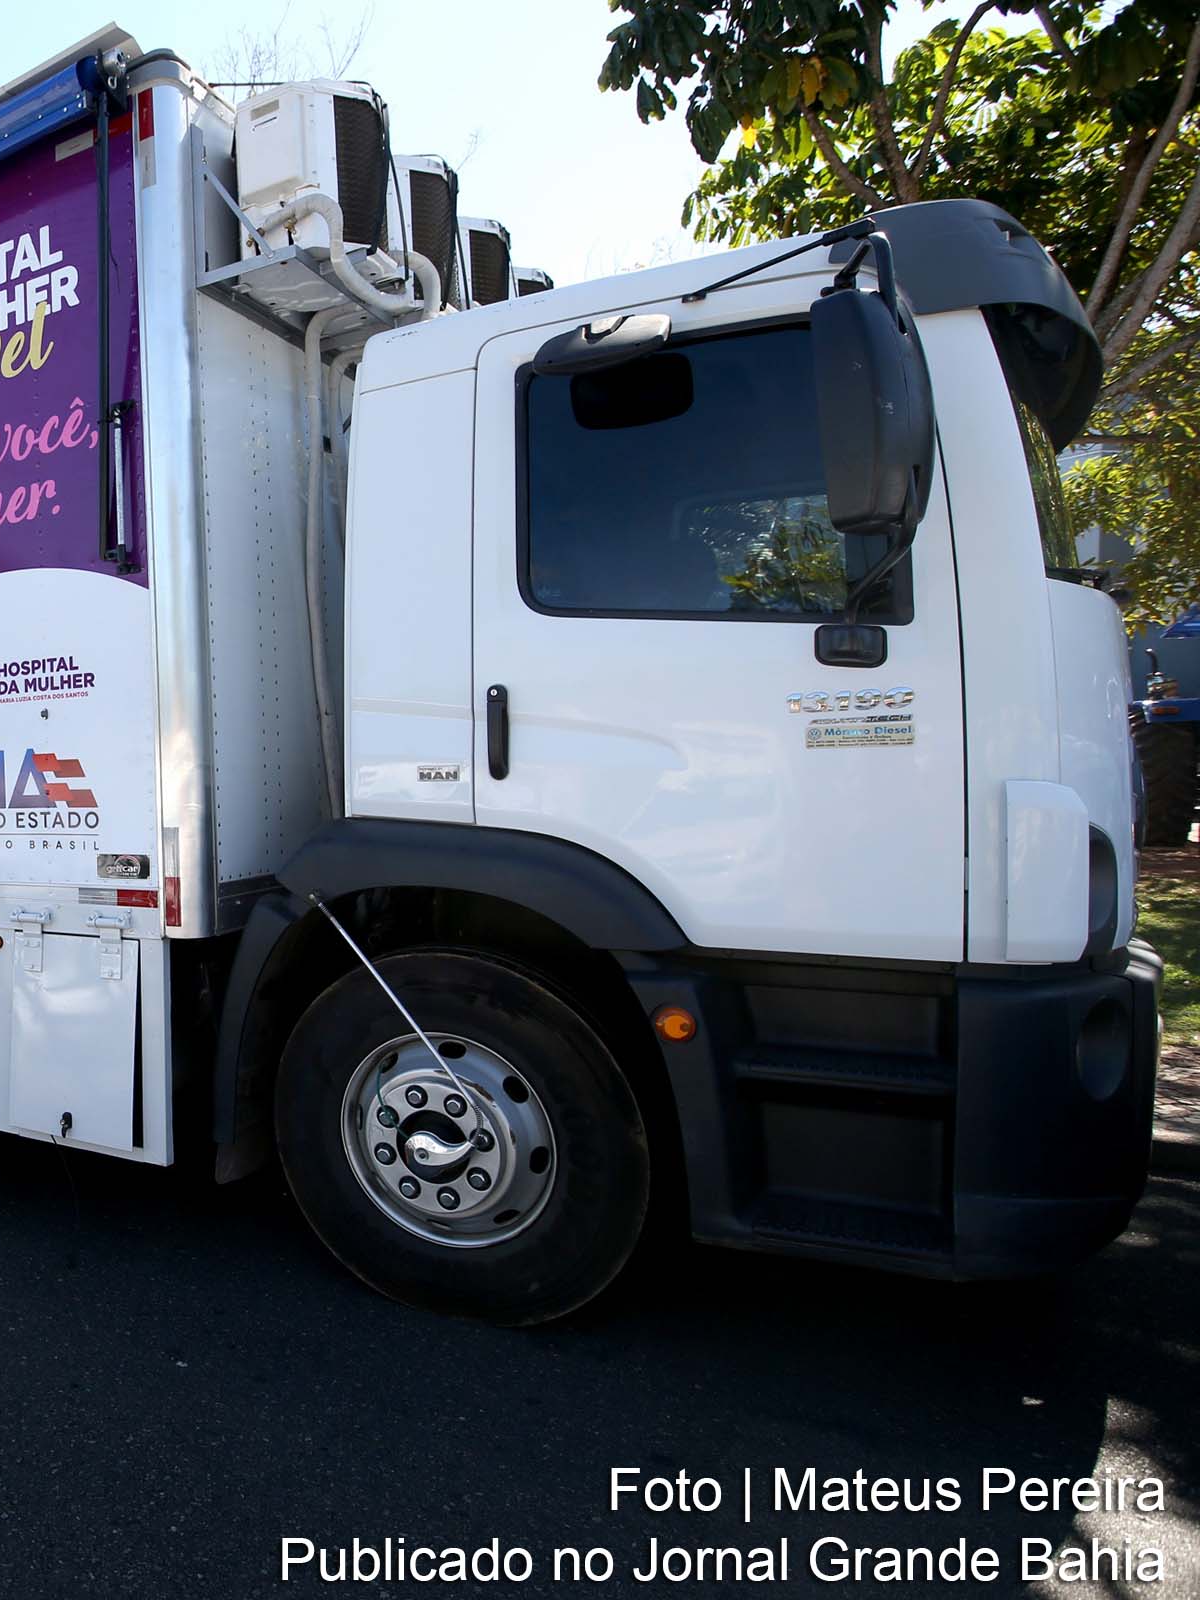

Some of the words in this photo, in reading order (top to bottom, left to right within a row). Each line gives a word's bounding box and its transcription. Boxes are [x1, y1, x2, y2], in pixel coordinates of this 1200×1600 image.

[24, 672, 95, 693] MULHER
[874, 725, 912, 735] Diesel
[419, 771, 458, 780] MAN
[16, 811, 99, 829] ESTADO
[29, 840, 99, 850] BRASIL
